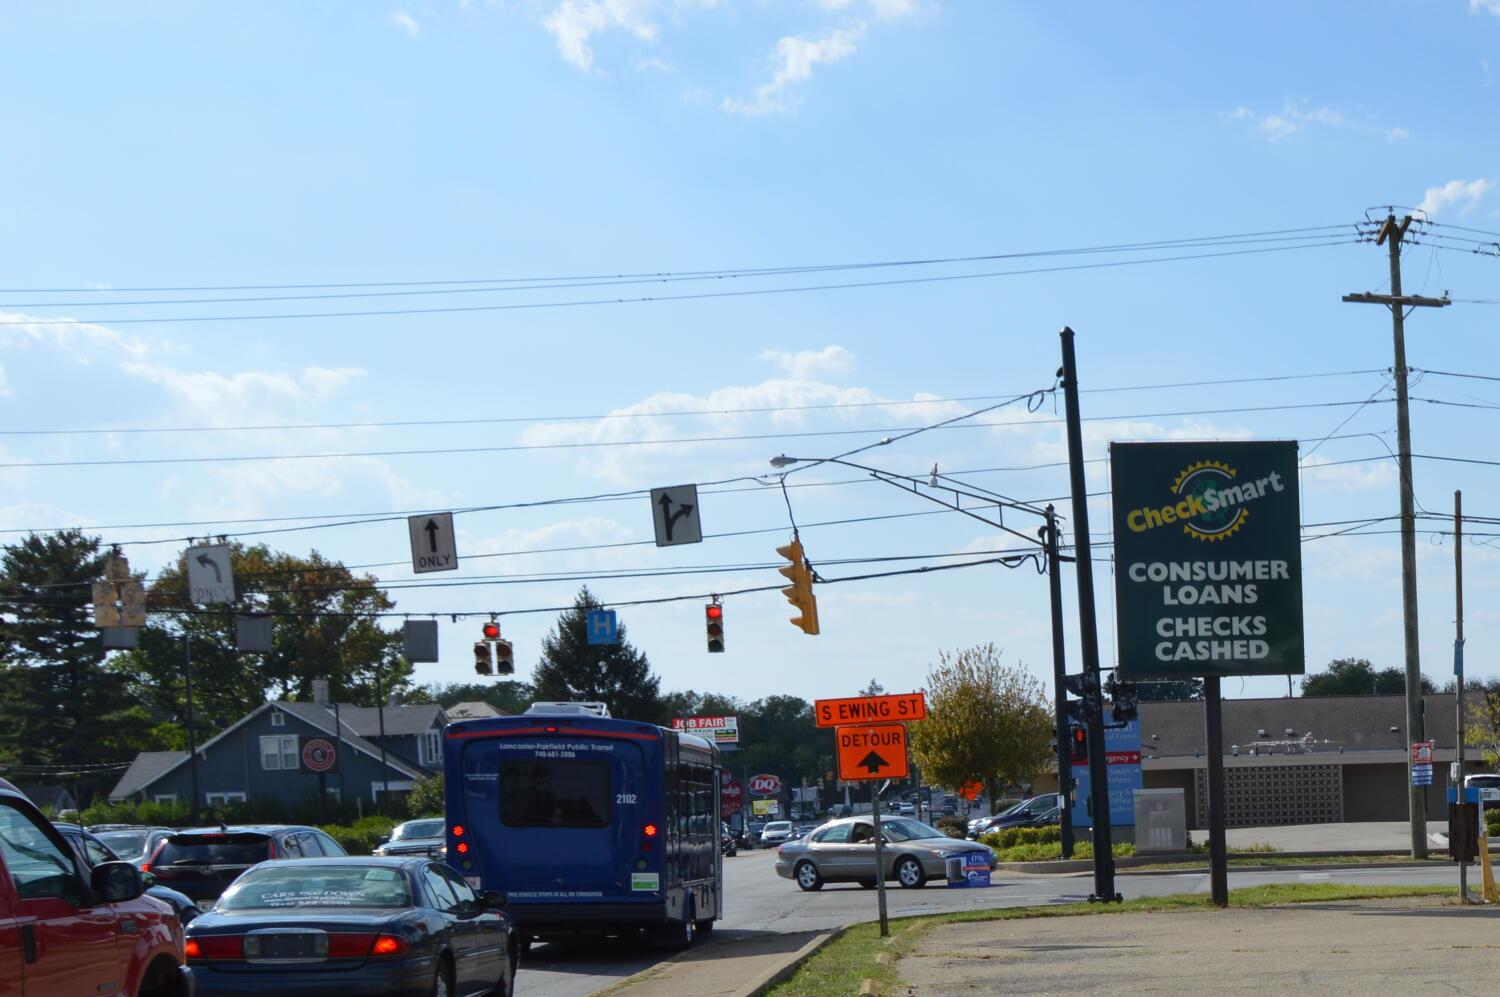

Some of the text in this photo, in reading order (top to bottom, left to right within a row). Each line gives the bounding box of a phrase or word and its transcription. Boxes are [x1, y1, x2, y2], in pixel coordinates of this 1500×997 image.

[419, 554, 450, 568] ONLY
[1128, 560, 1290, 582] CONSUMER
[1163, 584, 1258, 605] LOANS
[594, 615, 611, 635] H
[1156, 616, 1267, 637] CHECKS
[1155, 640, 1269, 661] CASHED
[822, 699, 918, 720] S EWING ST
[699, 718, 725, 728] FAIR
[567, 743, 589, 751] Public
[842, 733, 901, 747] DETOUR
[754, 779, 775, 790] DQ
[616, 794, 637, 804] 2102
[261, 891, 295, 899] CARS
